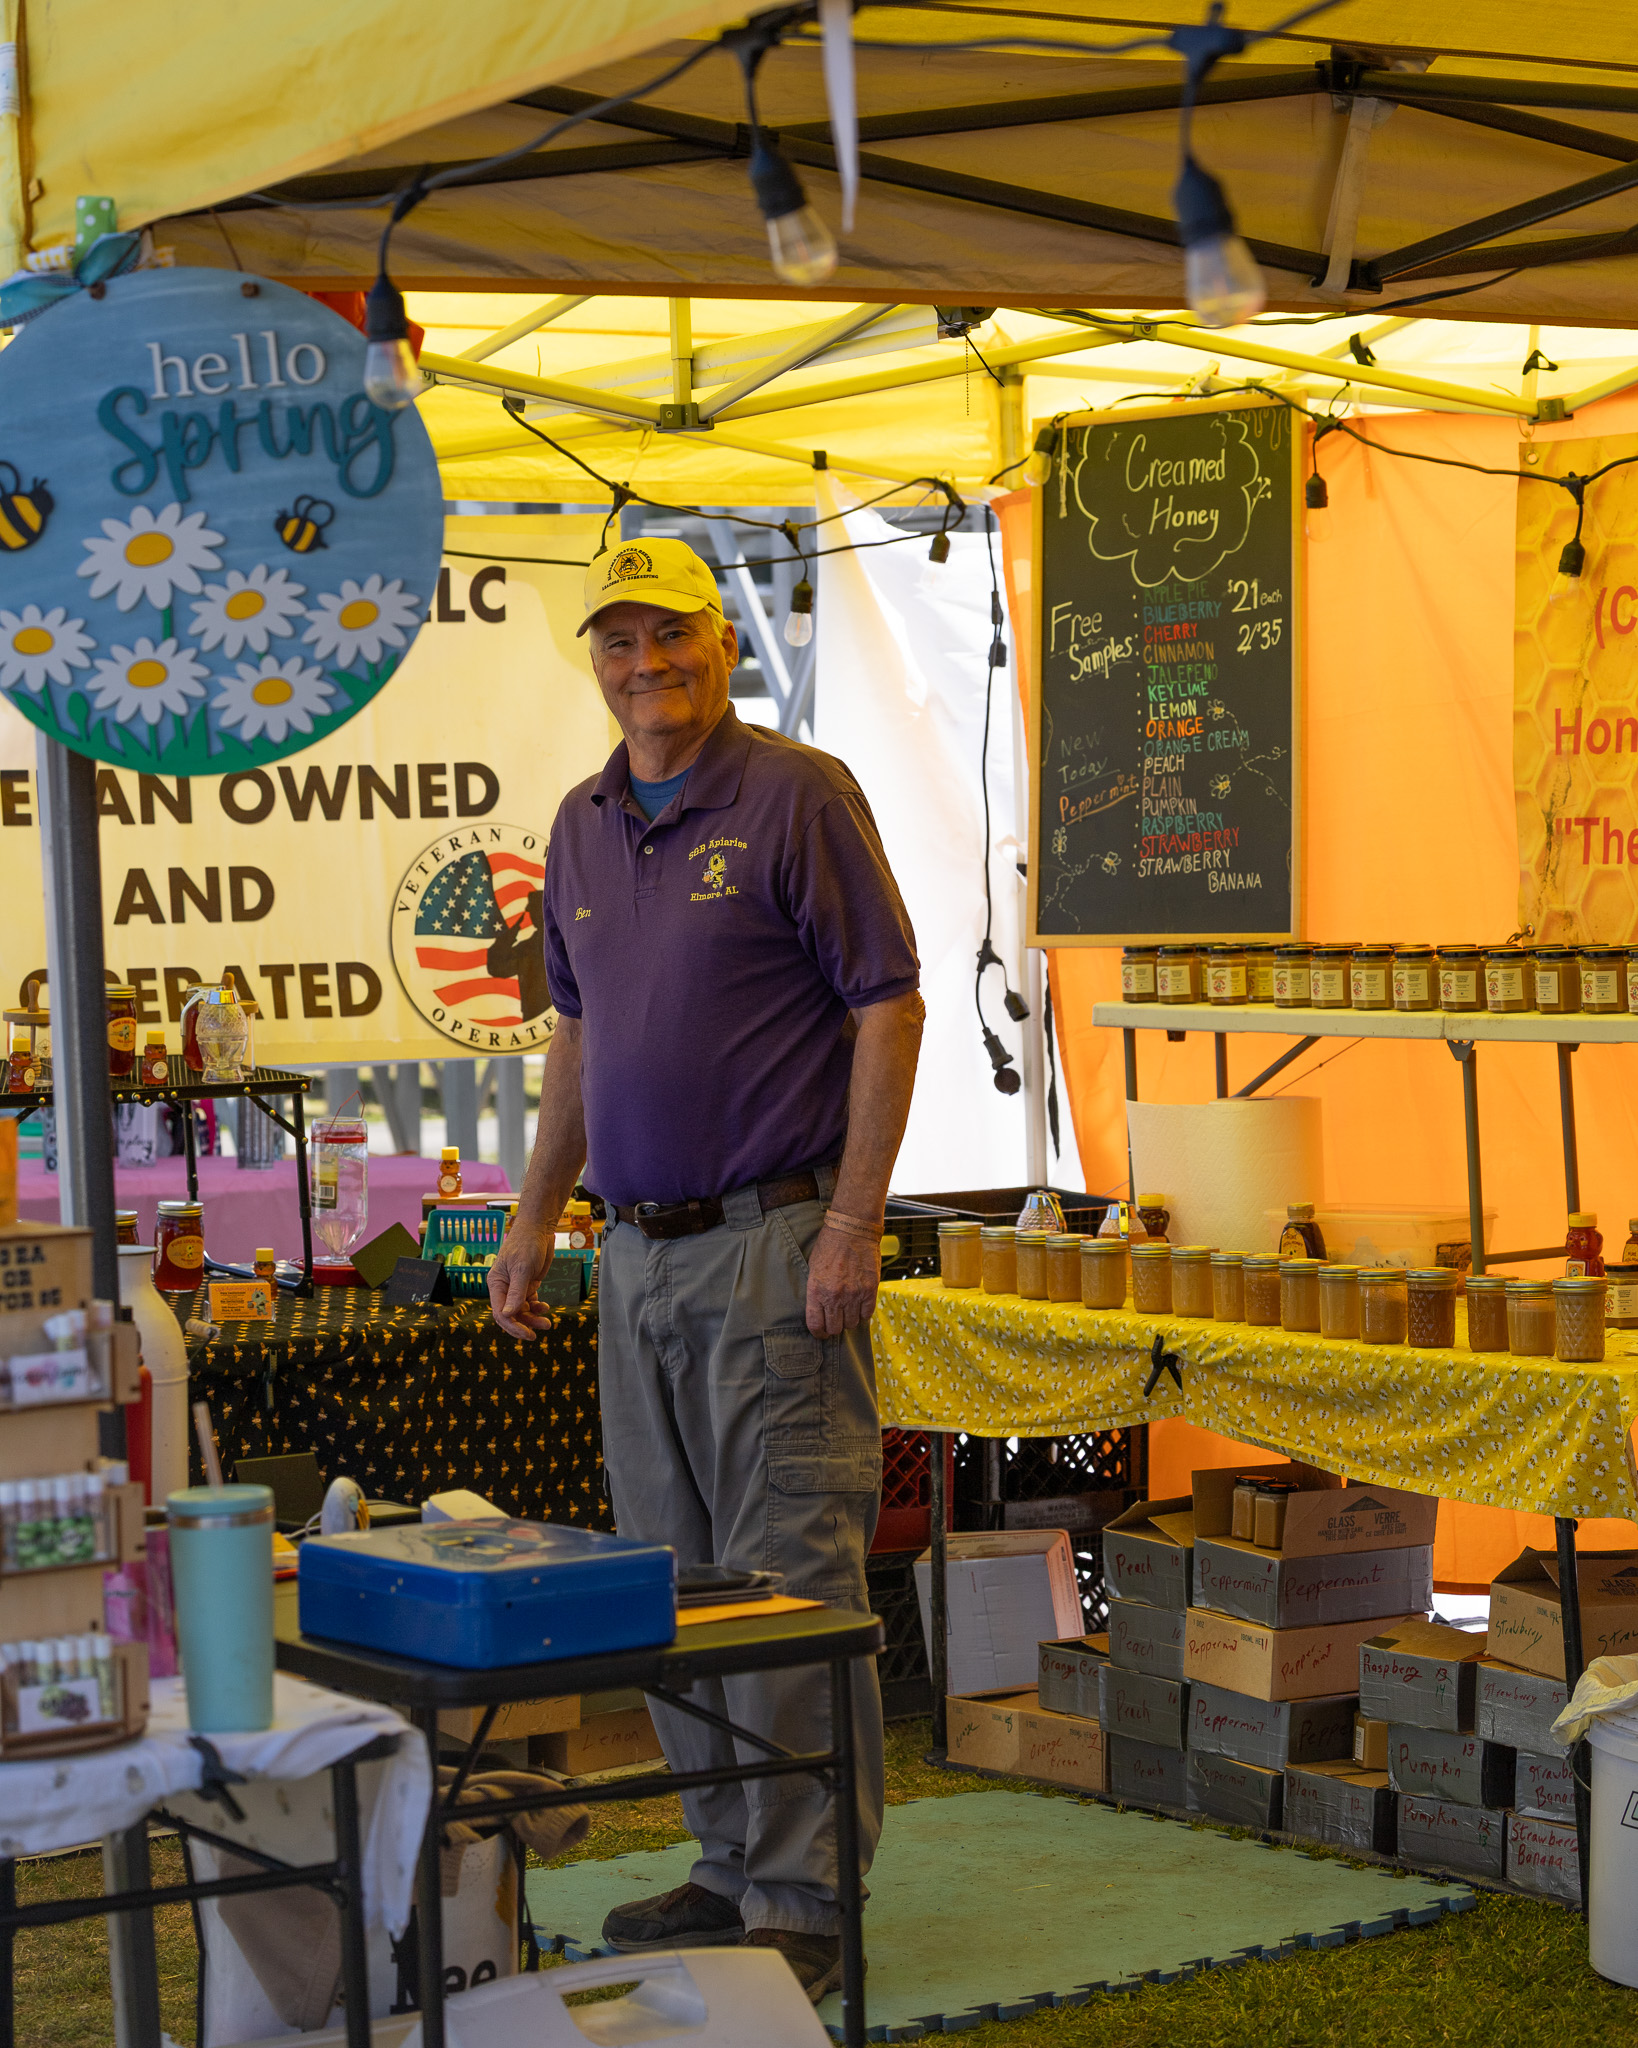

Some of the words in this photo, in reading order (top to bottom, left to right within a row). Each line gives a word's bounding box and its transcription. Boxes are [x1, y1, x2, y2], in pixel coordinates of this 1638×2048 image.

[146, 331, 326, 400] hello
[97, 385, 403, 501] Spring
[1126, 434, 1226, 492] Creamed
[1149, 495, 1219, 552] Honey
[426, 566, 506, 624] LC
[1144, 582, 1184, 604] APPLE
[1187, 579, 1210, 601] PIE
[1227, 578, 1258, 613] $21
[1260, 589, 1282, 605] each
[1050, 601, 1102, 652] Free
[1144, 623, 1198, 644] CHERRY
[1069, 636, 1133, 681] Samples
[1143, 642, 1215, 664] CINNAMON
[1148, 684, 1174, 702] KEY
[1178, 681, 1209, 698] LIME
[1149, 699, 1197, 721] LEMON
[1146, 717, 1204, 740] ORANGE
[1555, 707, 1638, 755] Hon
[1144, 736, 1202, 758] ORANGE
[1207, 730, 1250, 752] CREAM
[1057, 754, 1107, 784] Today
[1143, 754, 1185, 776] PEACH
[0, 769, 192, 826] EAN
[219, 762, 501, 824] OWNED
[1142, 776, 1182, 798] PLAIN
[1142, 797, 1197, 817] PUMPKIN
[1142, 812, 1224, 836] RASPBERRY
[708, 836, 748, 851] Apiaries
[1140, 827, 1240, 858] STRAWBERRY
[397, 828, 502, 913] VETERAN
[1138, 849, 1231, 878] STRAWBERRY
[114, 866, 275, 925] AND
[690, 891, 723, 902] Elmore,
[725, 885, 739, 895] AL
[1208, 871, 1263, 894] BANANA
[575, 907, 592, 921] Ben
[1327, 1515, 1356, 1529] GLASS
[1374, 1511, 1401, 1524] VERRE
[1115, 1553, 1154, 1578] Peach
[1284, 1563, 1385, 1604] Peppermint
[1601, 1579, 1636, 1588] GLASS
[1118, 1621, 1154, 1660] Peach
[1041, 1654, 1077, 1680] Orange
[1116, 1689, 1150, 1723] Peach
[582, 1730, 641, 1752] Lemon
[1463, 1742, 1475, 1757] 13
[1134, 1760, 1164, 1777] Peach
[1400, 1743, 1461, 1782] Pumpkin
[1288, 1776, 1318, 1800] Plain
[1403, 1798, 1458, 1830] Pumpkin
[1511, 1822, 1578, 1852] Strawberr
[1518, 1843, 1563, 1870] Banana
